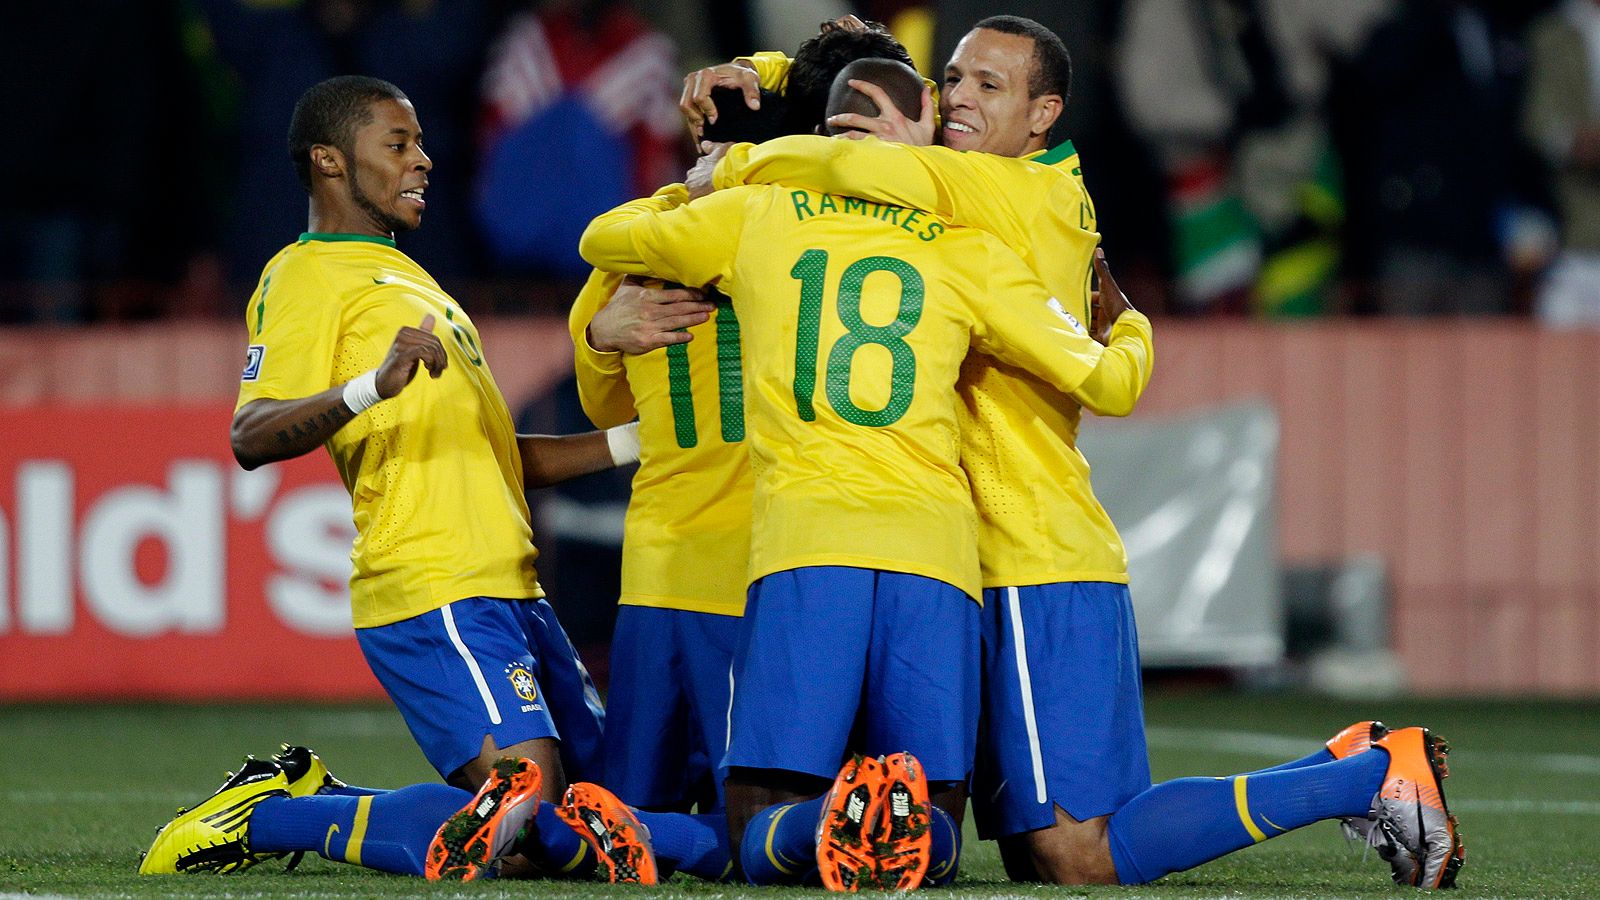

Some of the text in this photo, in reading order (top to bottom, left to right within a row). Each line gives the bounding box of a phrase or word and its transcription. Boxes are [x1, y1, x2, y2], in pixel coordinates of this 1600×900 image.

[790, 190, 945, 241] RAMIRES
[663, 283, 746, 448] 11
[790, 249, 925, 427] 18
[0, 459, 354, 639] ld's
[476, 796, 496, 818] NIKE
[892, 792, 910, 817] NIKE
